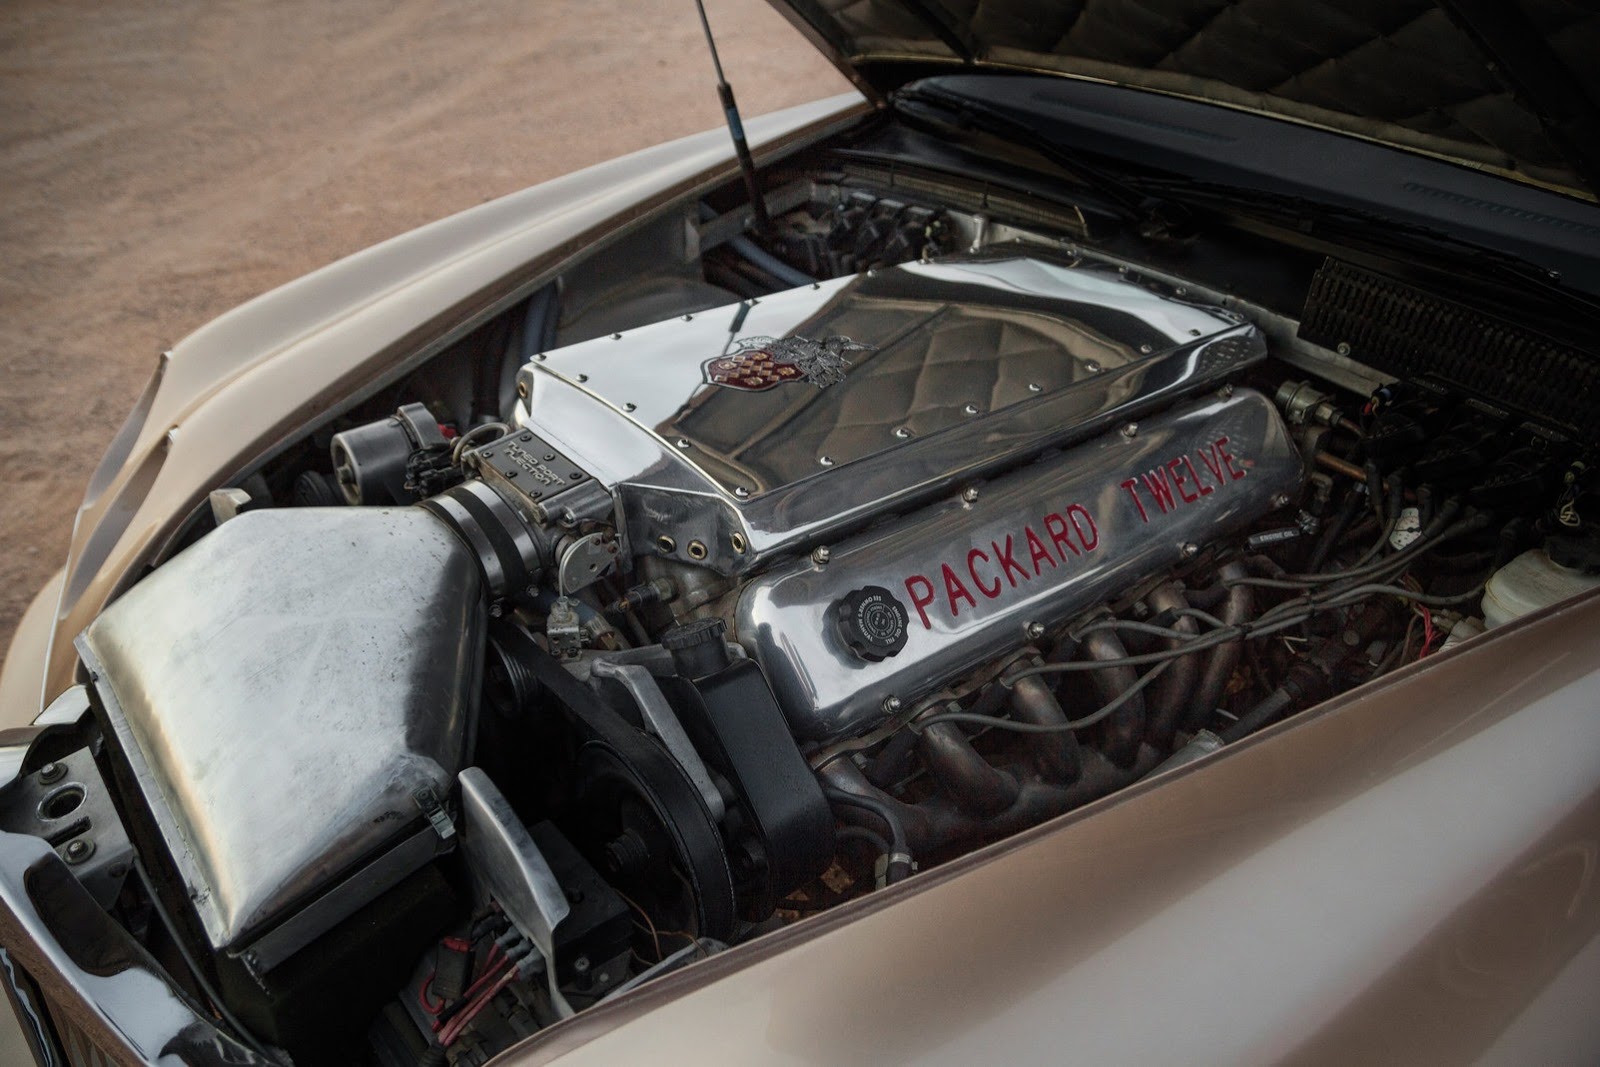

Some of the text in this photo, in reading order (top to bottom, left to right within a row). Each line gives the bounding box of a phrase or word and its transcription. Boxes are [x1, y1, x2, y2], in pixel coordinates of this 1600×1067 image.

[504, 448, 551, 486] INJECTION
[537, 464, 566, 486] PORT
[904, 436, 1247, 631] PACKARD TWELVE
[892, 605, 903, 628] ENGINE
[858, 618, 873, 642] MANUAL
[885, 636, 896, 645] FILL
[894, 628, 902, 638] OIL
